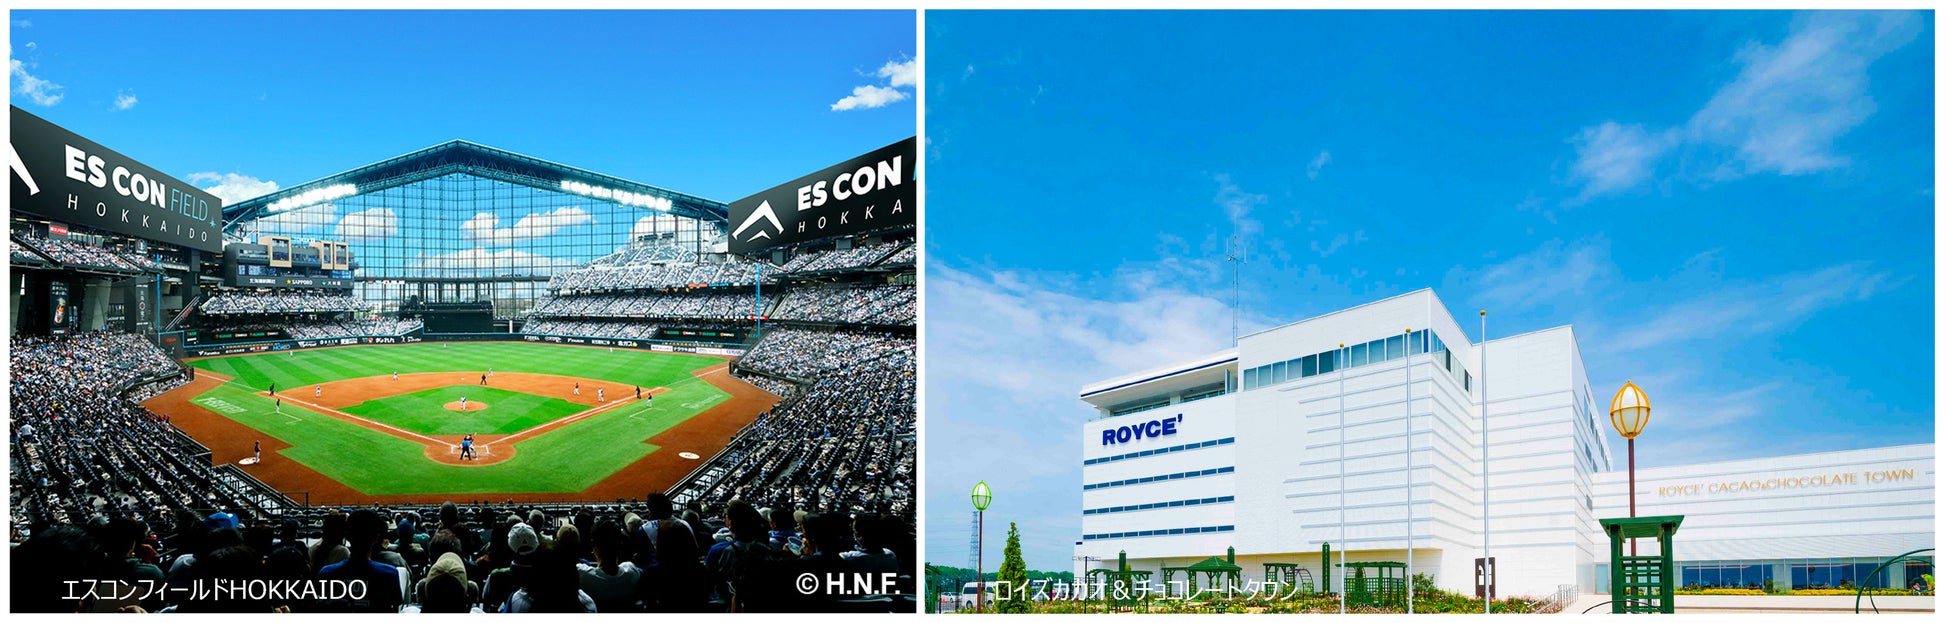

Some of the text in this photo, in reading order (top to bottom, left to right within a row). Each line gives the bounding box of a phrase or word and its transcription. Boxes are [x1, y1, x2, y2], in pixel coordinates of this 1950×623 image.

[65, 145, 208, 222] ES CON FIELD
[797, 156, 902, 212] ES CON
[67, 193, 208, 242] HOKKAIDO
[797, 199, 903, 234] HOKKA
[1102, 413, 1183, 446] ROYCE'
[1658, 484, 1704, 497] ROYCE'
[1864, 468, 1915, 484] TOWN
